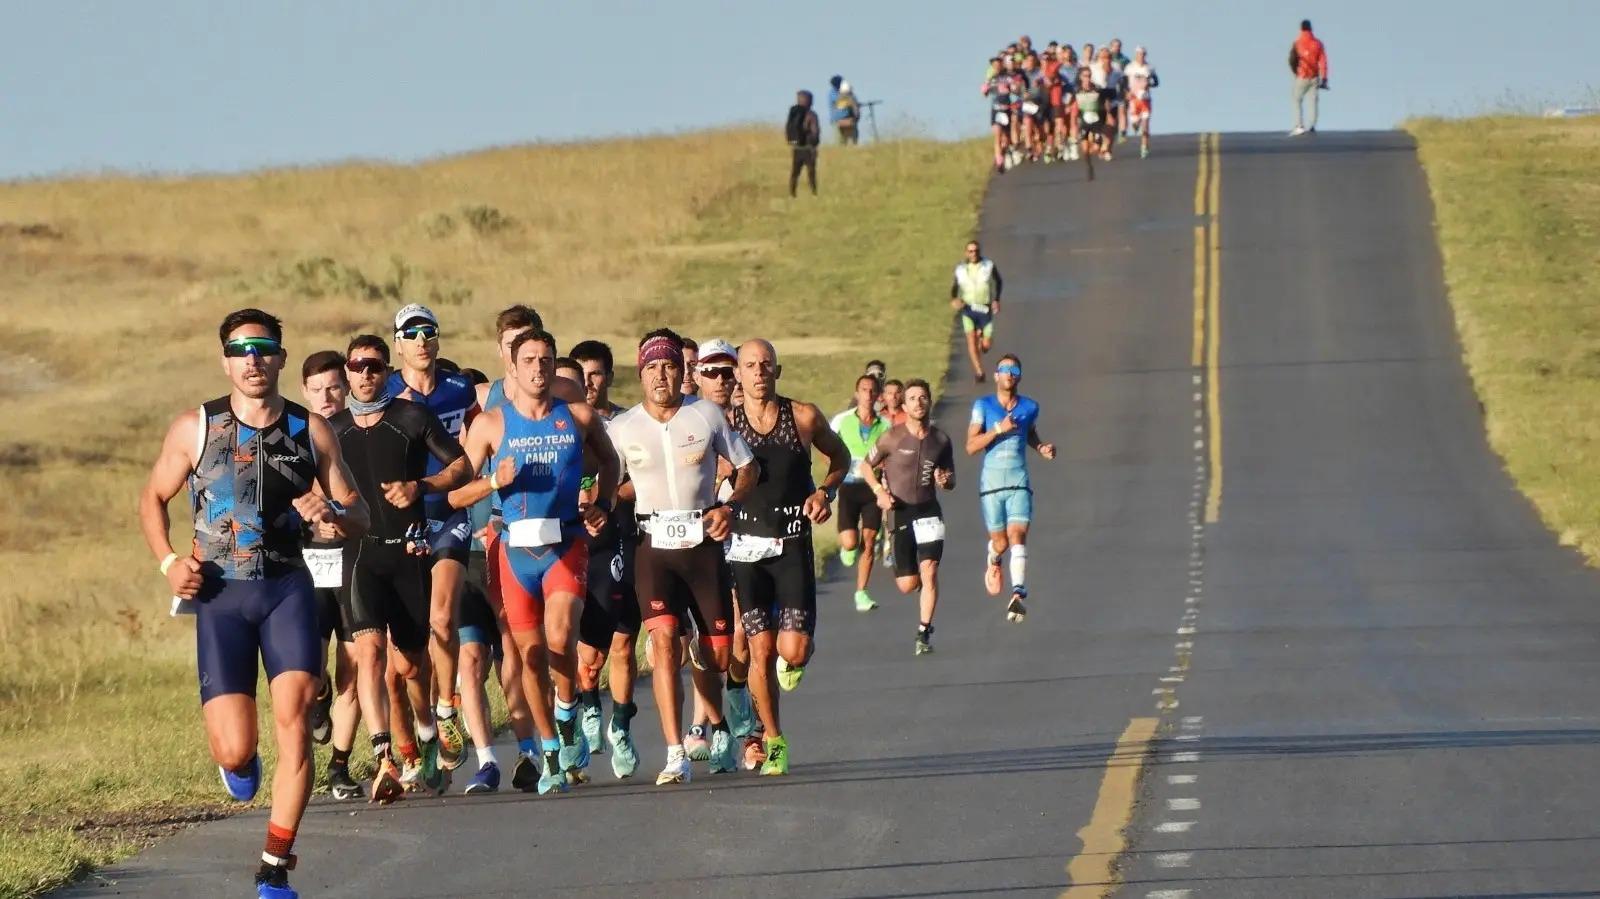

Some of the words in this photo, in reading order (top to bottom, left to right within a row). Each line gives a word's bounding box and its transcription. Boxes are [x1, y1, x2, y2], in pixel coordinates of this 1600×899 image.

[508, 436, 543, 448] VASCO
[544, 434, 575, 445] TEAM
[525, 450, 558, 464] CAMPI
[666, 524, 686, 538] 09
